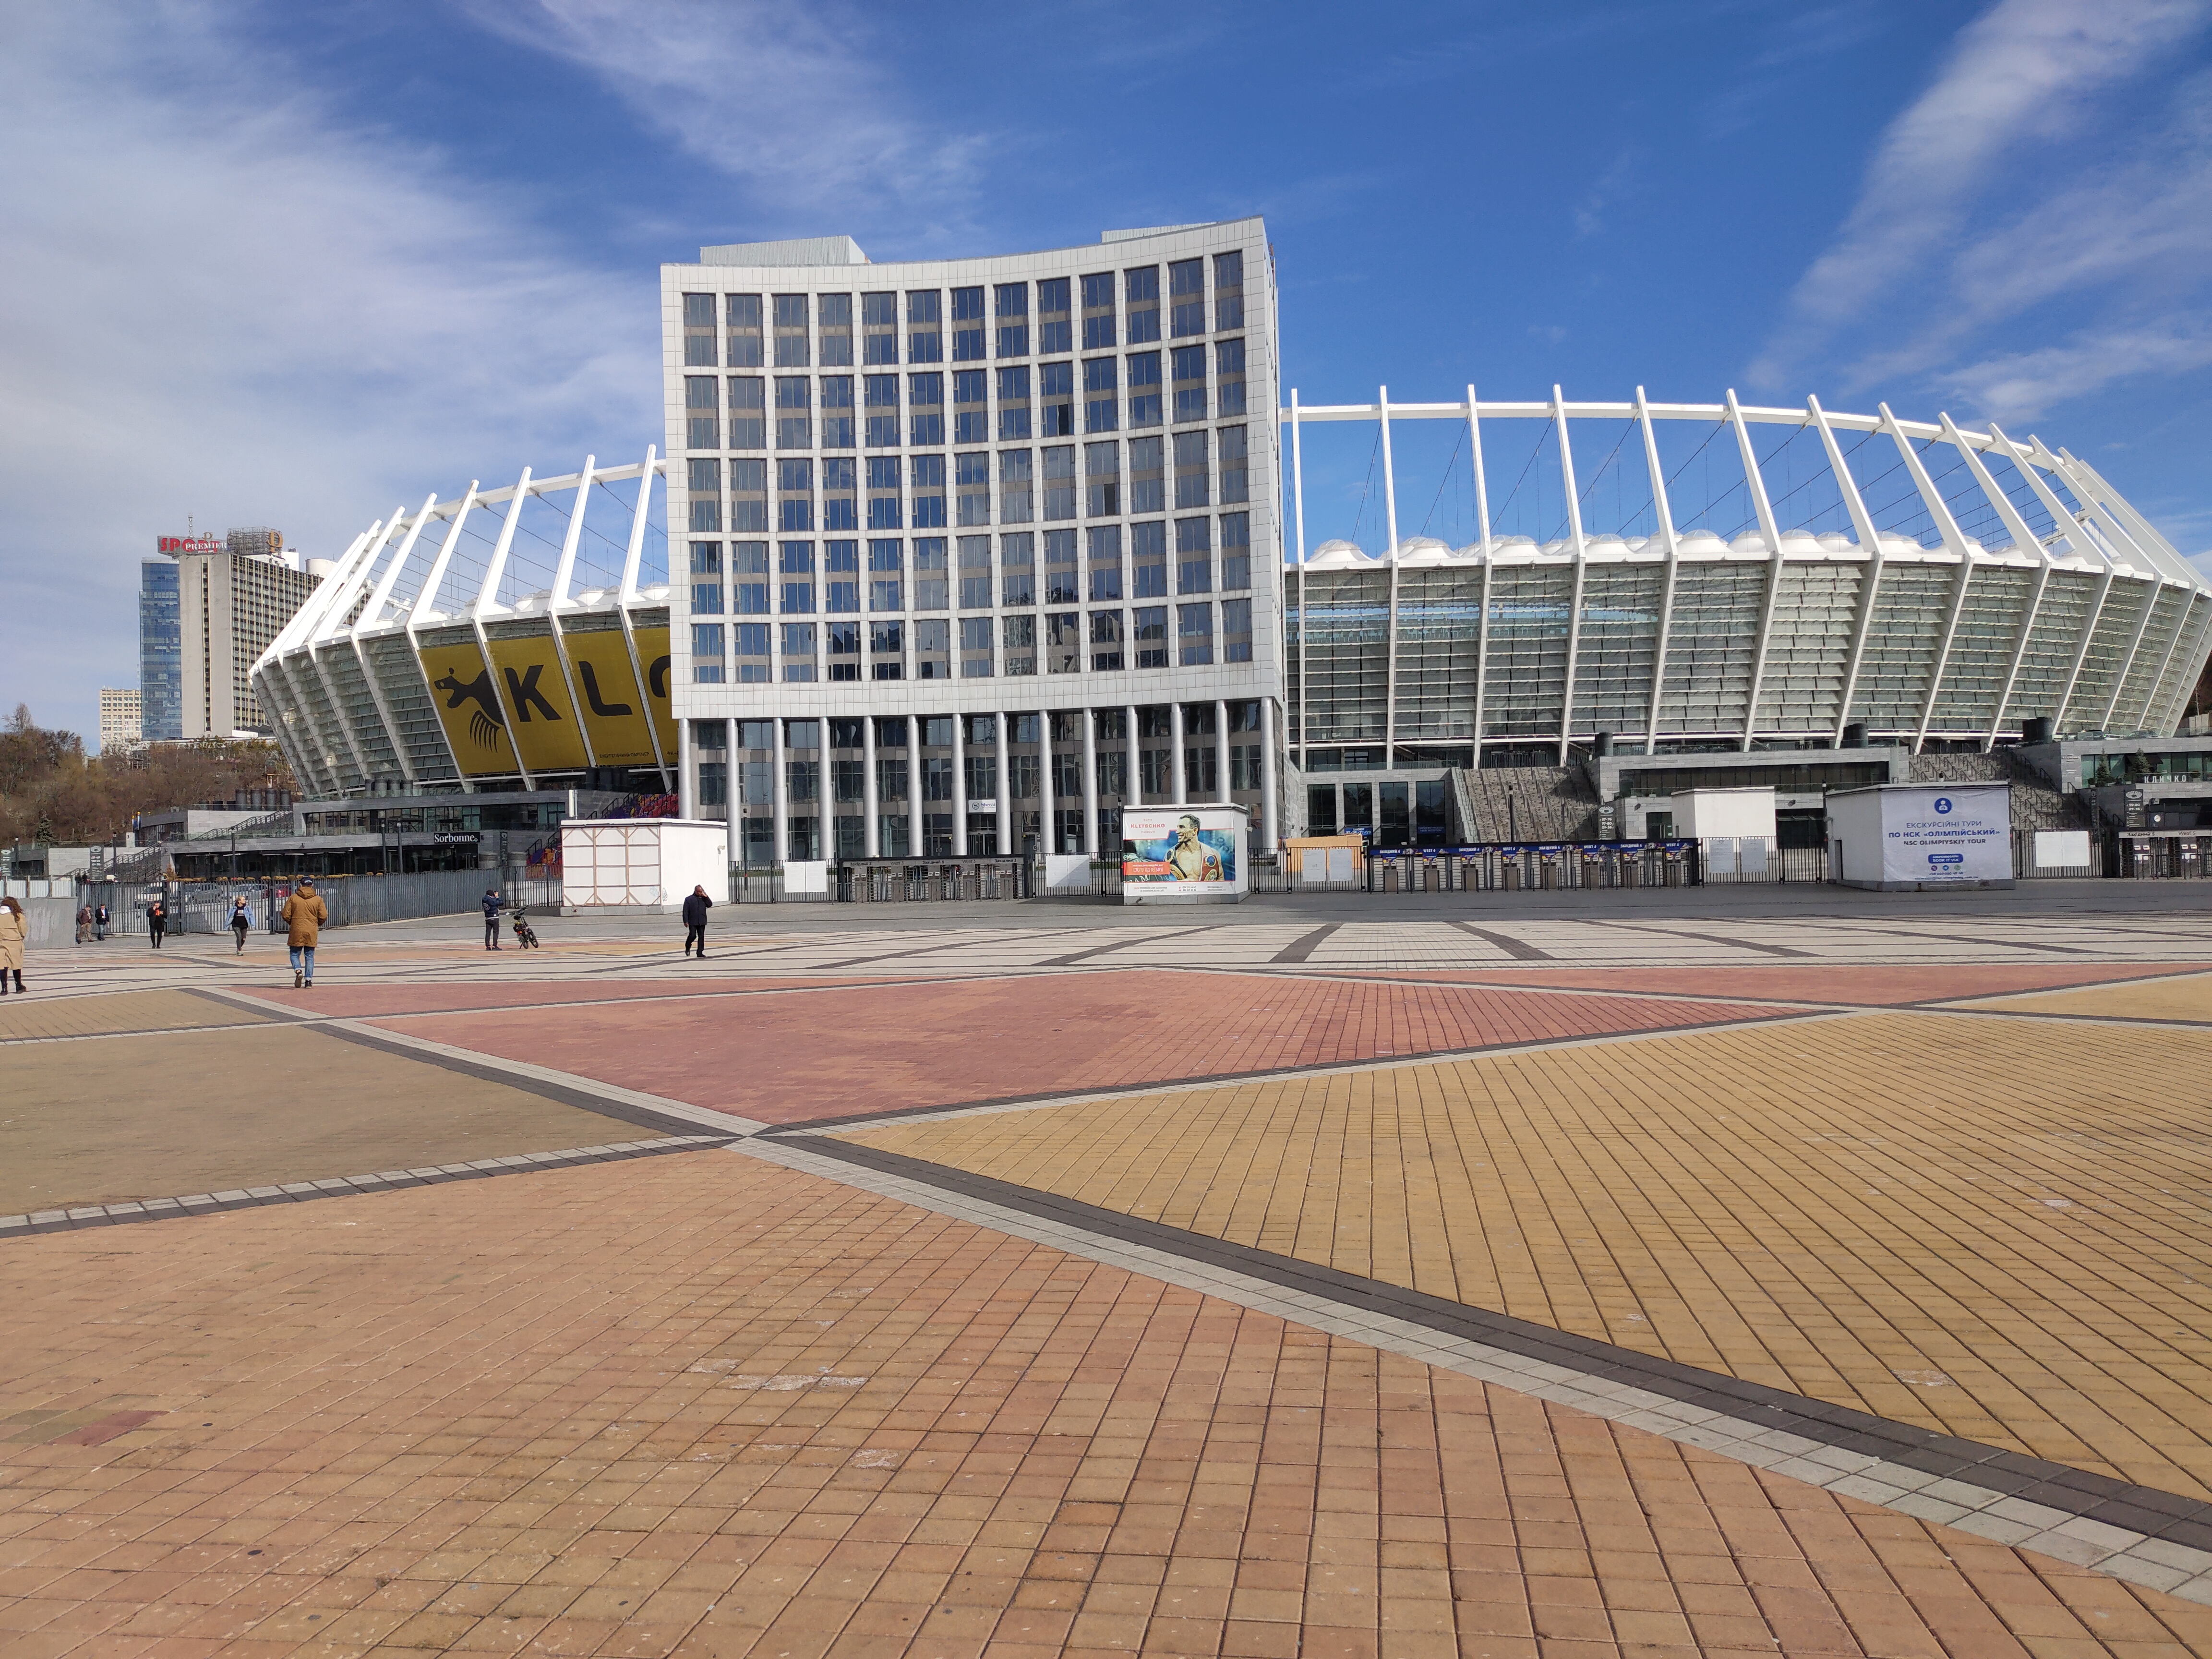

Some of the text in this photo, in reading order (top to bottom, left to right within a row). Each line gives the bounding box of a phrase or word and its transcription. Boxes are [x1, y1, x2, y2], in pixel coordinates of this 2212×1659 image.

[186, 542, 227, 550] PREMIER
[2144, 775, 2187, 783] КЛИЧКО
[1906, 820, 1960, 829] ЕКСКУРСІЙНІ
[1923, 828, 2000, 837] «ОЛІМПІЙСЬКИЙ»
[434, 833, 475, 843] Sorbonne
